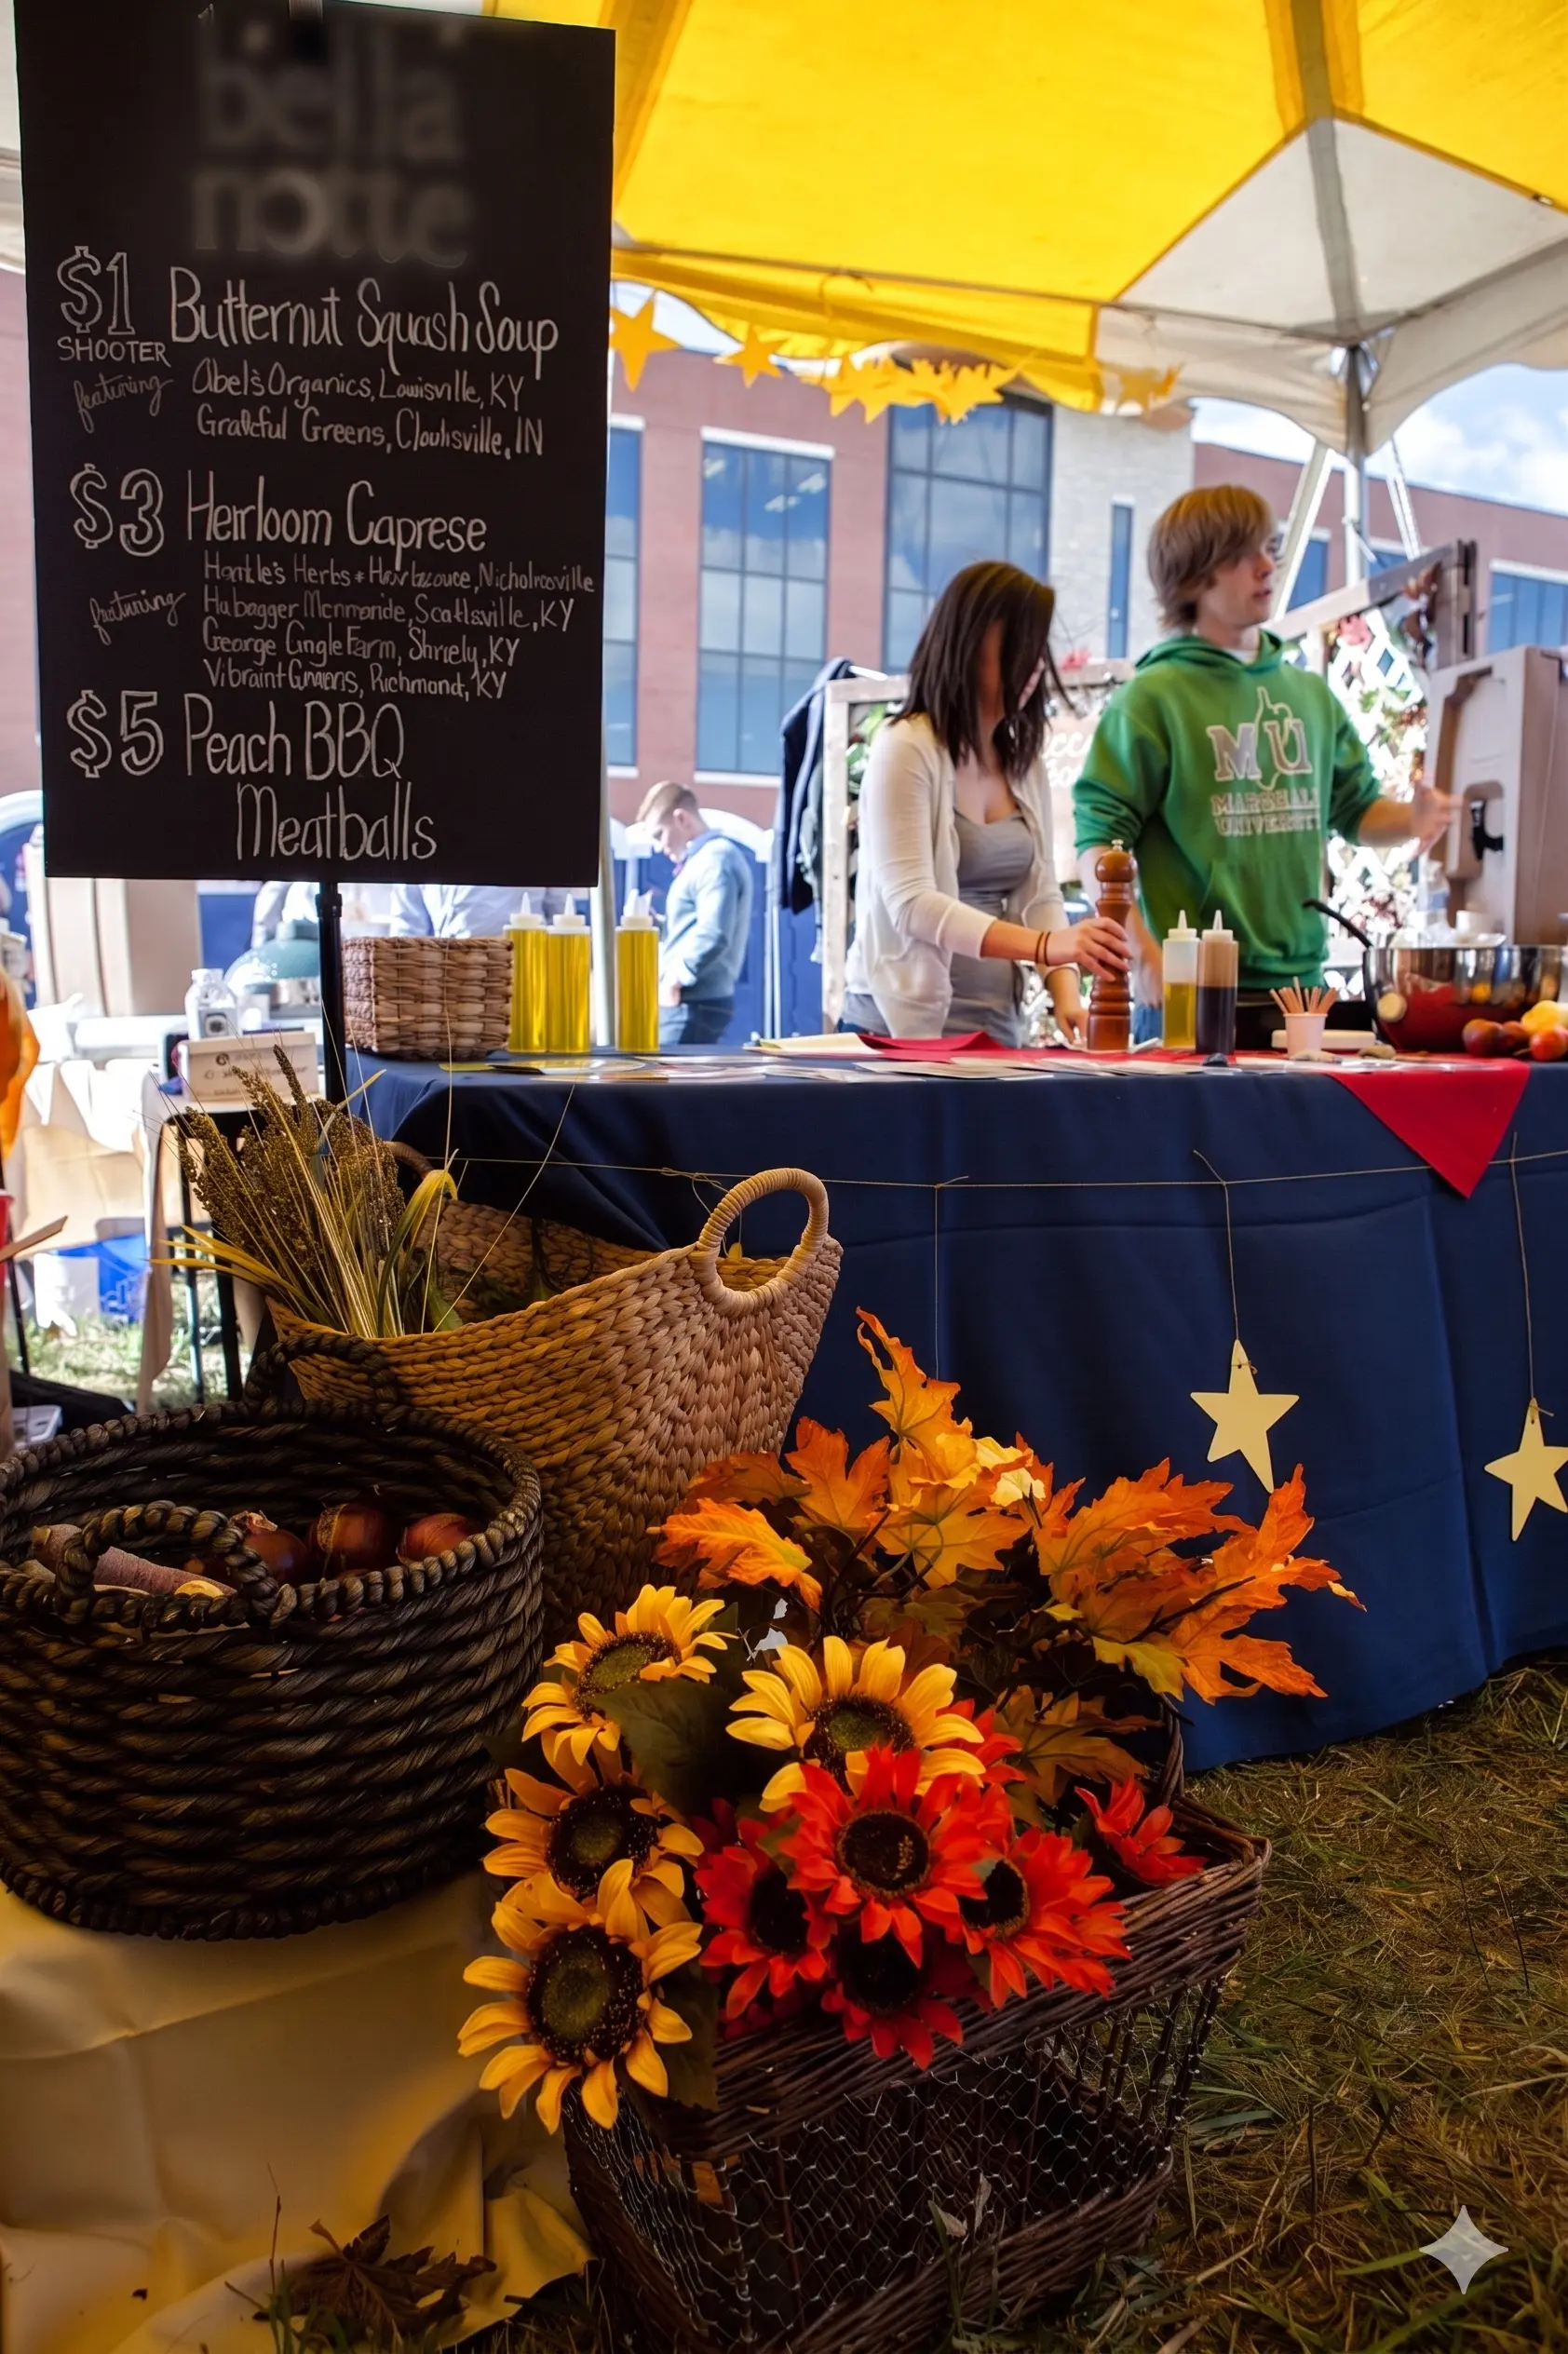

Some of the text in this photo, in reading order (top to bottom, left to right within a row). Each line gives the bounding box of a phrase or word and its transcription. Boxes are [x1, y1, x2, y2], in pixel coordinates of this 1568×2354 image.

[57, 246, 559, 381] $1 Butternut Squash Soup
[57, 336, 171, 368] SHOOTER
[268, 361, 375, 410] Organics,
[489, 372, 524, 412] KY
[301, 406, 392, 454] Greens,
[514, 415, 543, 455] IN
[70, 464, 487, 572] $3 Heirloom Caprese
[540, 597, 574, 632] KY
[202, 616, 277, 667] George
[489, 635, 520, 667] KY
[476, 670, 507, 699] KY
[66, 690, 404, 780] $5 Peach BBQ
[237, 781, 438, 861] Meatballs
